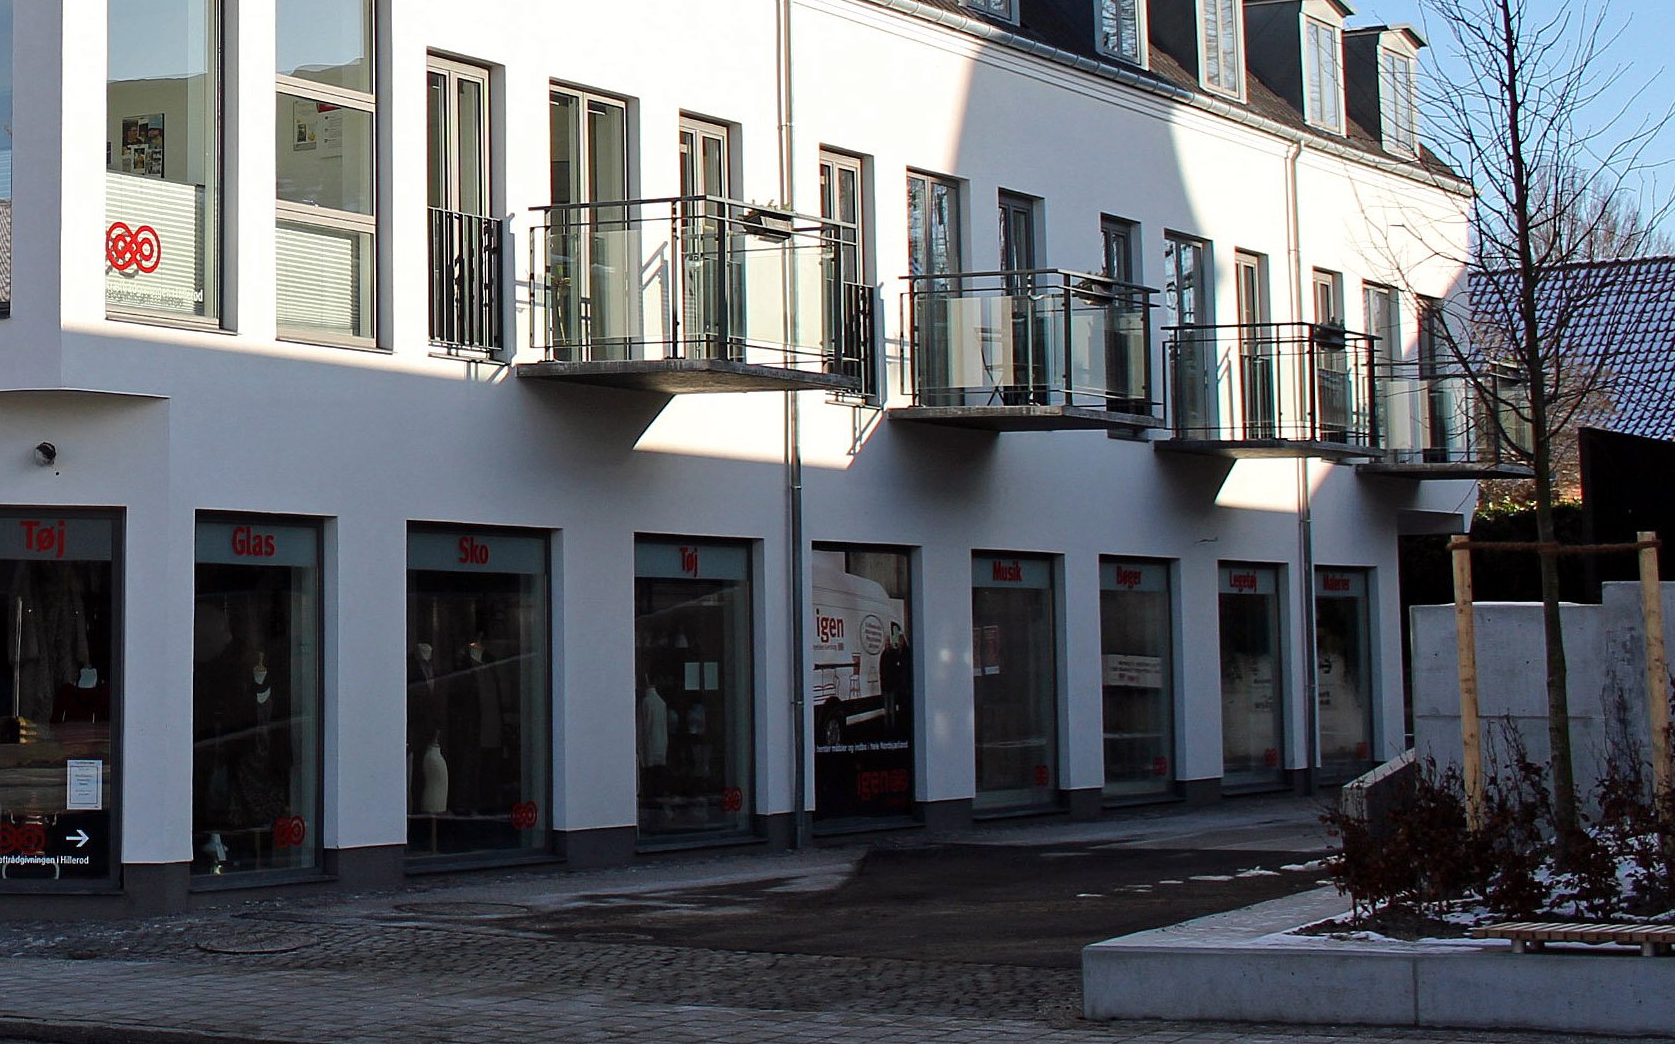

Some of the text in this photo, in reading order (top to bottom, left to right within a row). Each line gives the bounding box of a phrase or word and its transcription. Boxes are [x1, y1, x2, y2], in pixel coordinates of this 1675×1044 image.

[20, 519, 66, 557] Tøj
[232, 526, 276, 557] Glas
[458, 536, 489, 564] Sko
[679, 547, 698, 577] Tøj
[992, 561, 1023, 581] Musik
[815, 608, 844, 643] igen
